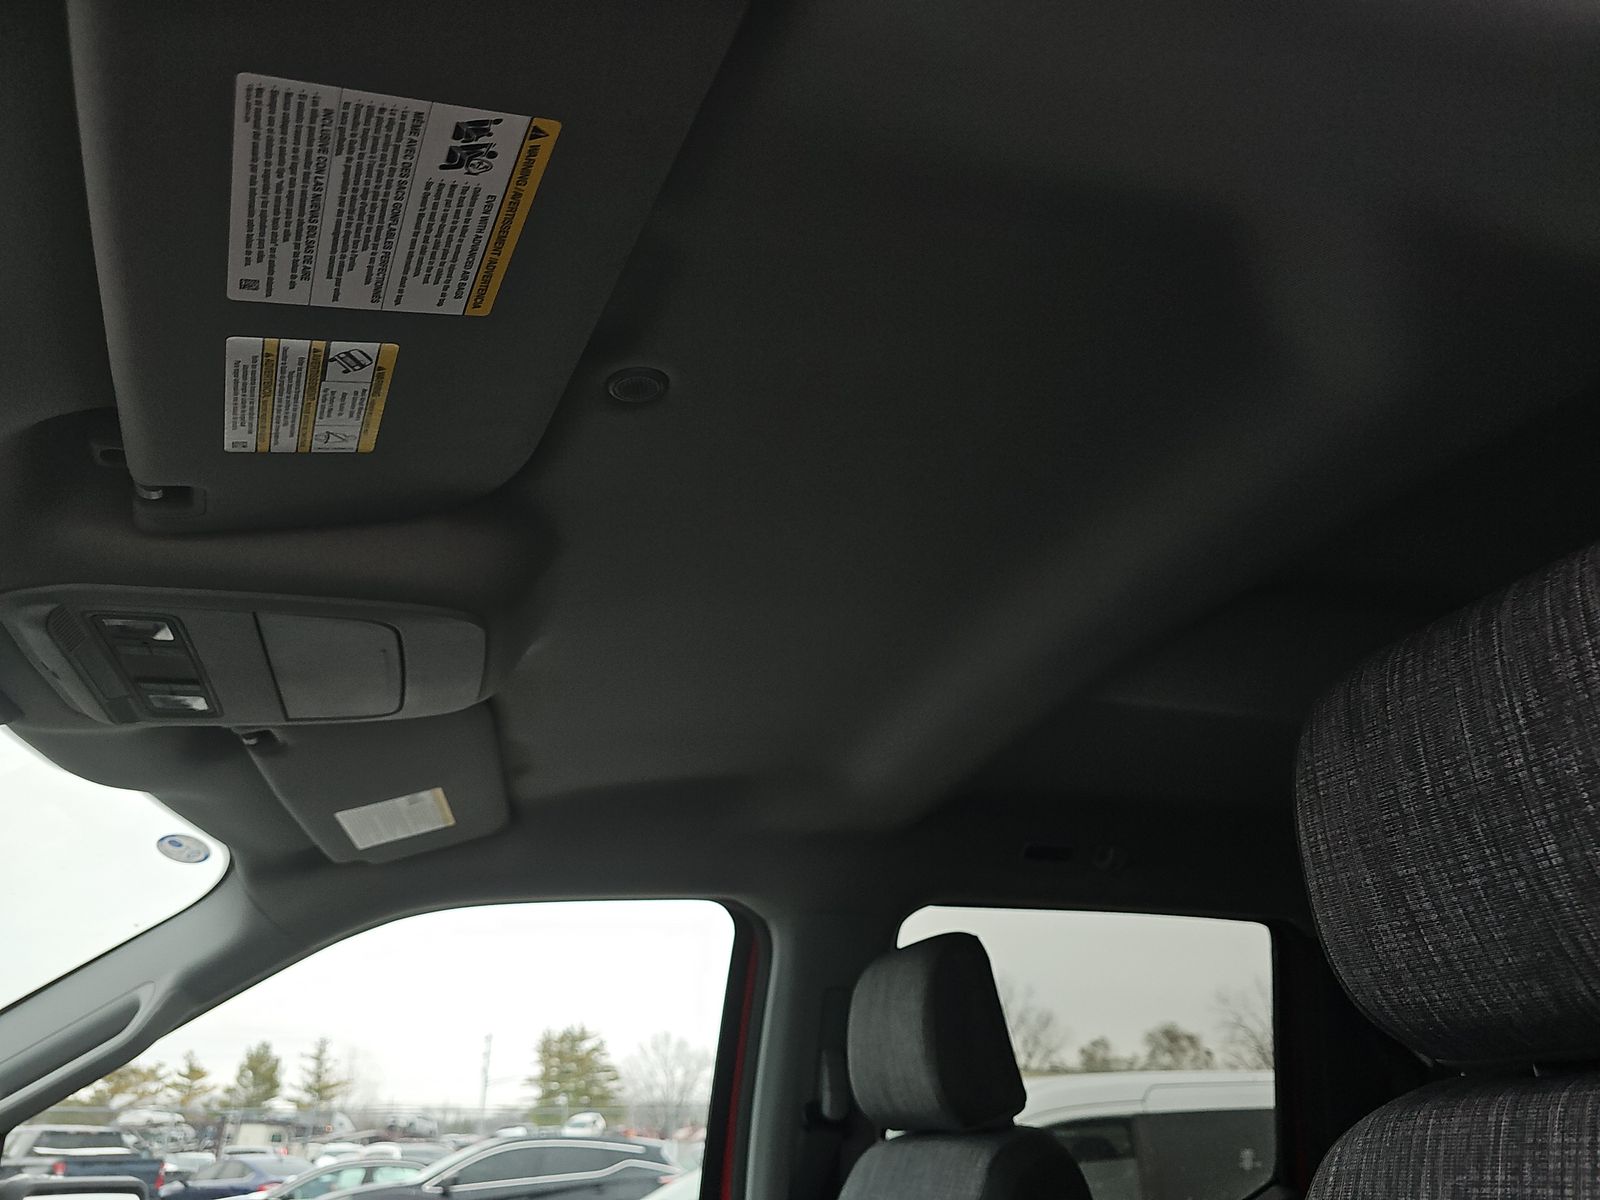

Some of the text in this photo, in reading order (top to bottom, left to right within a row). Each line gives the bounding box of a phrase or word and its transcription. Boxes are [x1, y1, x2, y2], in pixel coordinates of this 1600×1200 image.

[398, 161, 412, 179] DES
[403, 137, 418, 161] AVEC
[515, 143, 541, 186] WARNING
[300, 108, 334, 281] INCLUSIVE CON LAS NUEVAS BOLSAS DE AIRE
[393, 179, 408, 201] SACS
[490, 190, 524, 256] AVERTISSEMENT
[453, 194, 496, 299] EVEN WITH ADVANCED AIR BAGS
[471, 260, 498, 309] ADVERTENCIA
